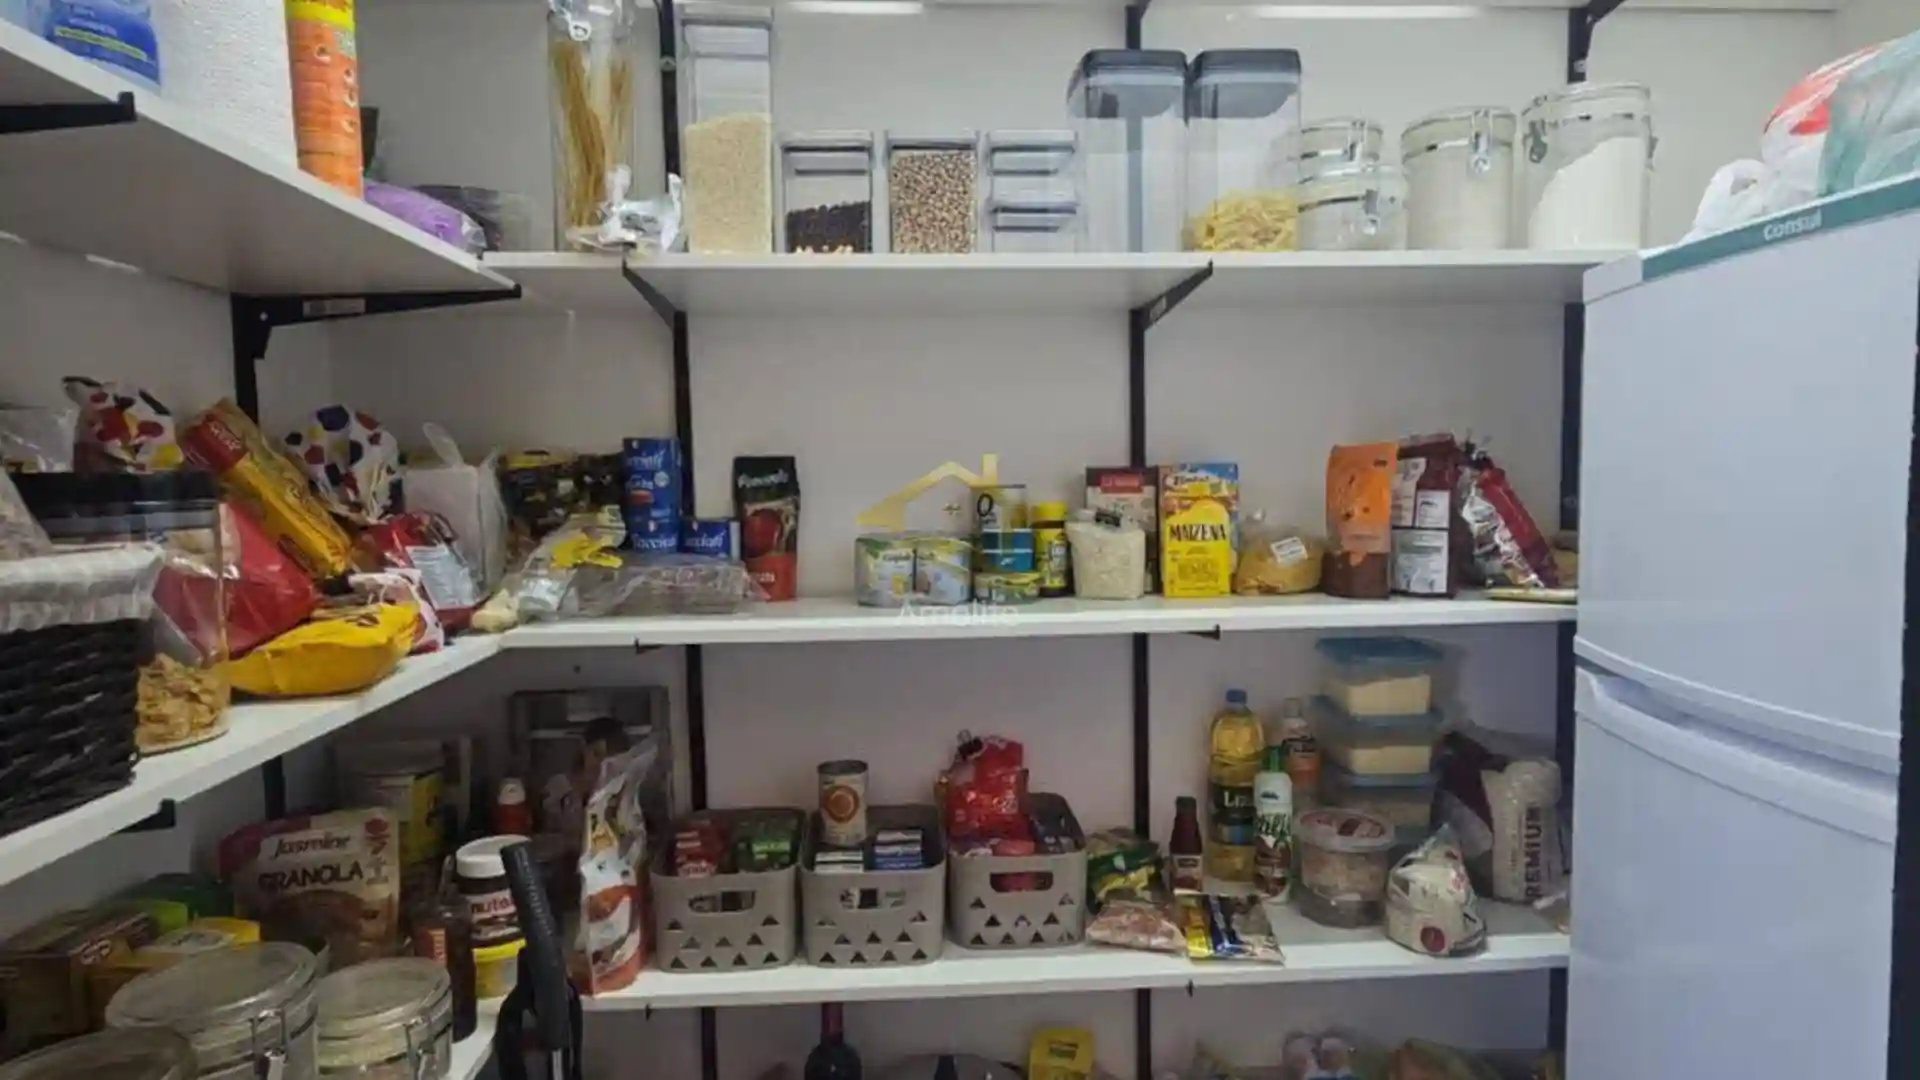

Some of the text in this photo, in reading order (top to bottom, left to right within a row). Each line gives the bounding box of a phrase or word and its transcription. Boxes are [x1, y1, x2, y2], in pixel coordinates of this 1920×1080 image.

[1169, 523, 1227, 542] MAIZENA
[1523, 806, 1542, 899] REMIUM
[257, 860, 364, 892] GRANOLA
